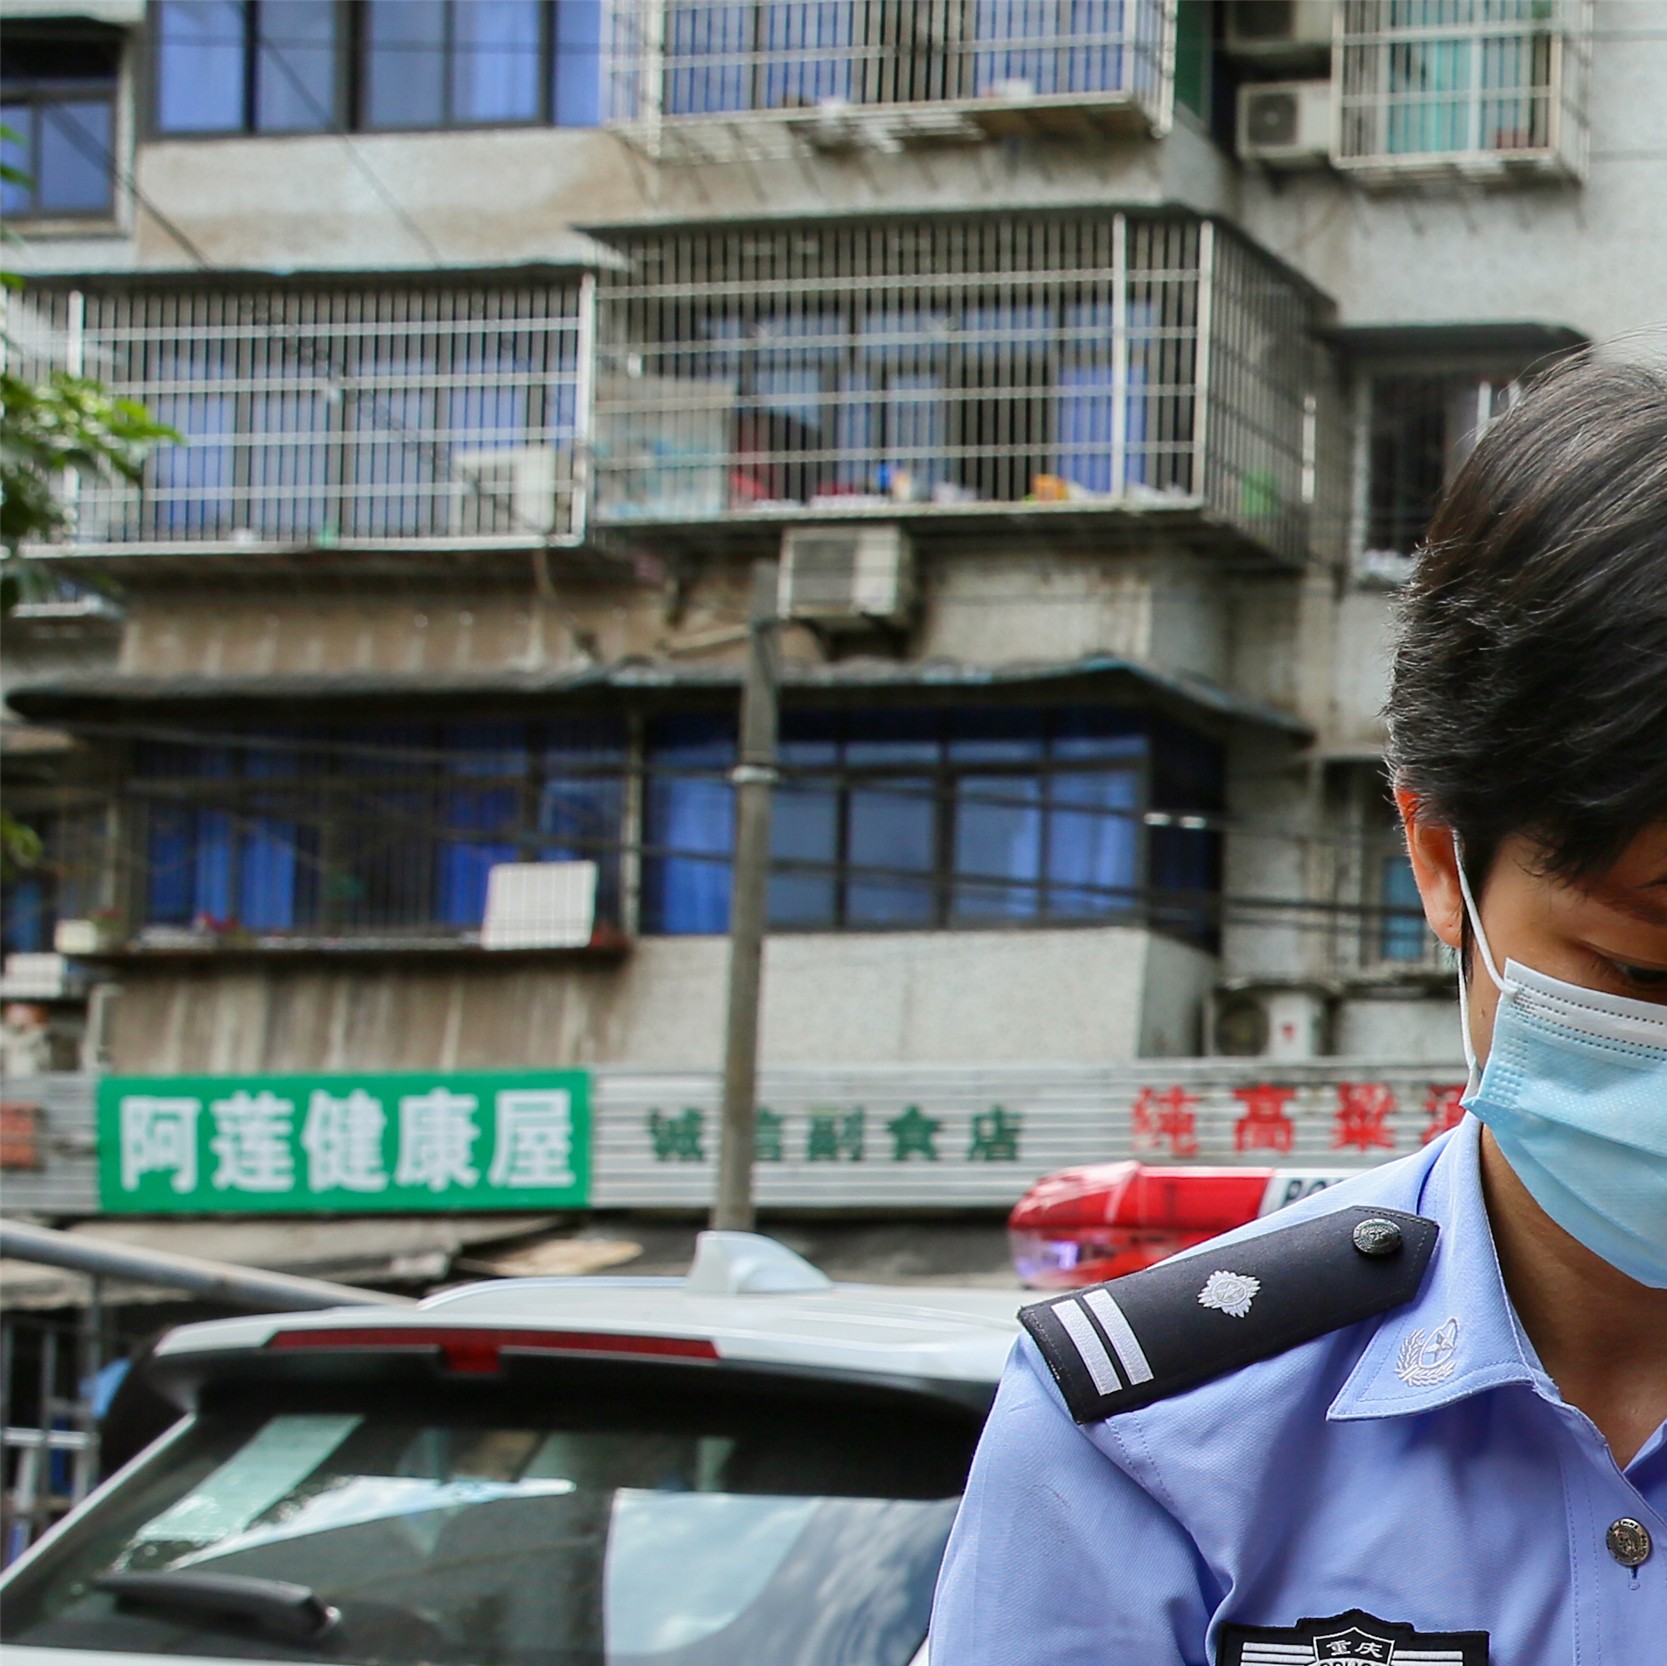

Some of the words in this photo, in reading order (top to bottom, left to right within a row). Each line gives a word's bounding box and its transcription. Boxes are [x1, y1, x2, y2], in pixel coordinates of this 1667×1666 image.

[119, 1087, 576, 1193] 阿莲健康屋
[1326, 1640, 1383, 1658] 重庆
